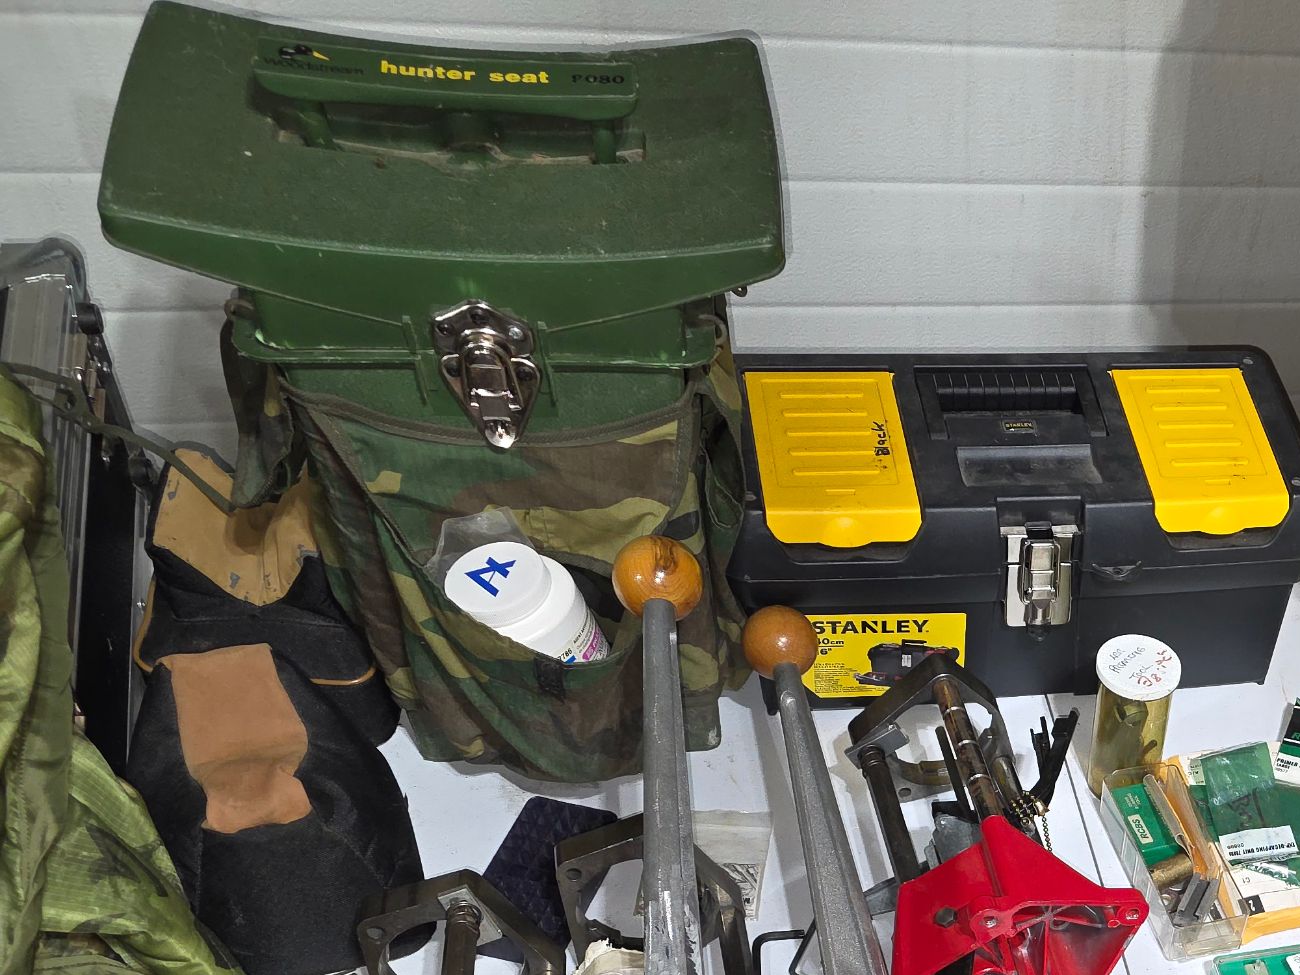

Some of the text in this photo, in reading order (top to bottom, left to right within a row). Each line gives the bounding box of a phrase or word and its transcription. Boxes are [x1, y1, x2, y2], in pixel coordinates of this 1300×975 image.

[380, 59, 550, 84] hunter seat
[1005, 421, 1033, 429] STANLEY
[871, 420, 890, 456] Black
[812, 619, 929, 635] STANLEY
[1276, 757, 1298, 767] PRIMER
[1131, 818, 1150, 840] RCBS
